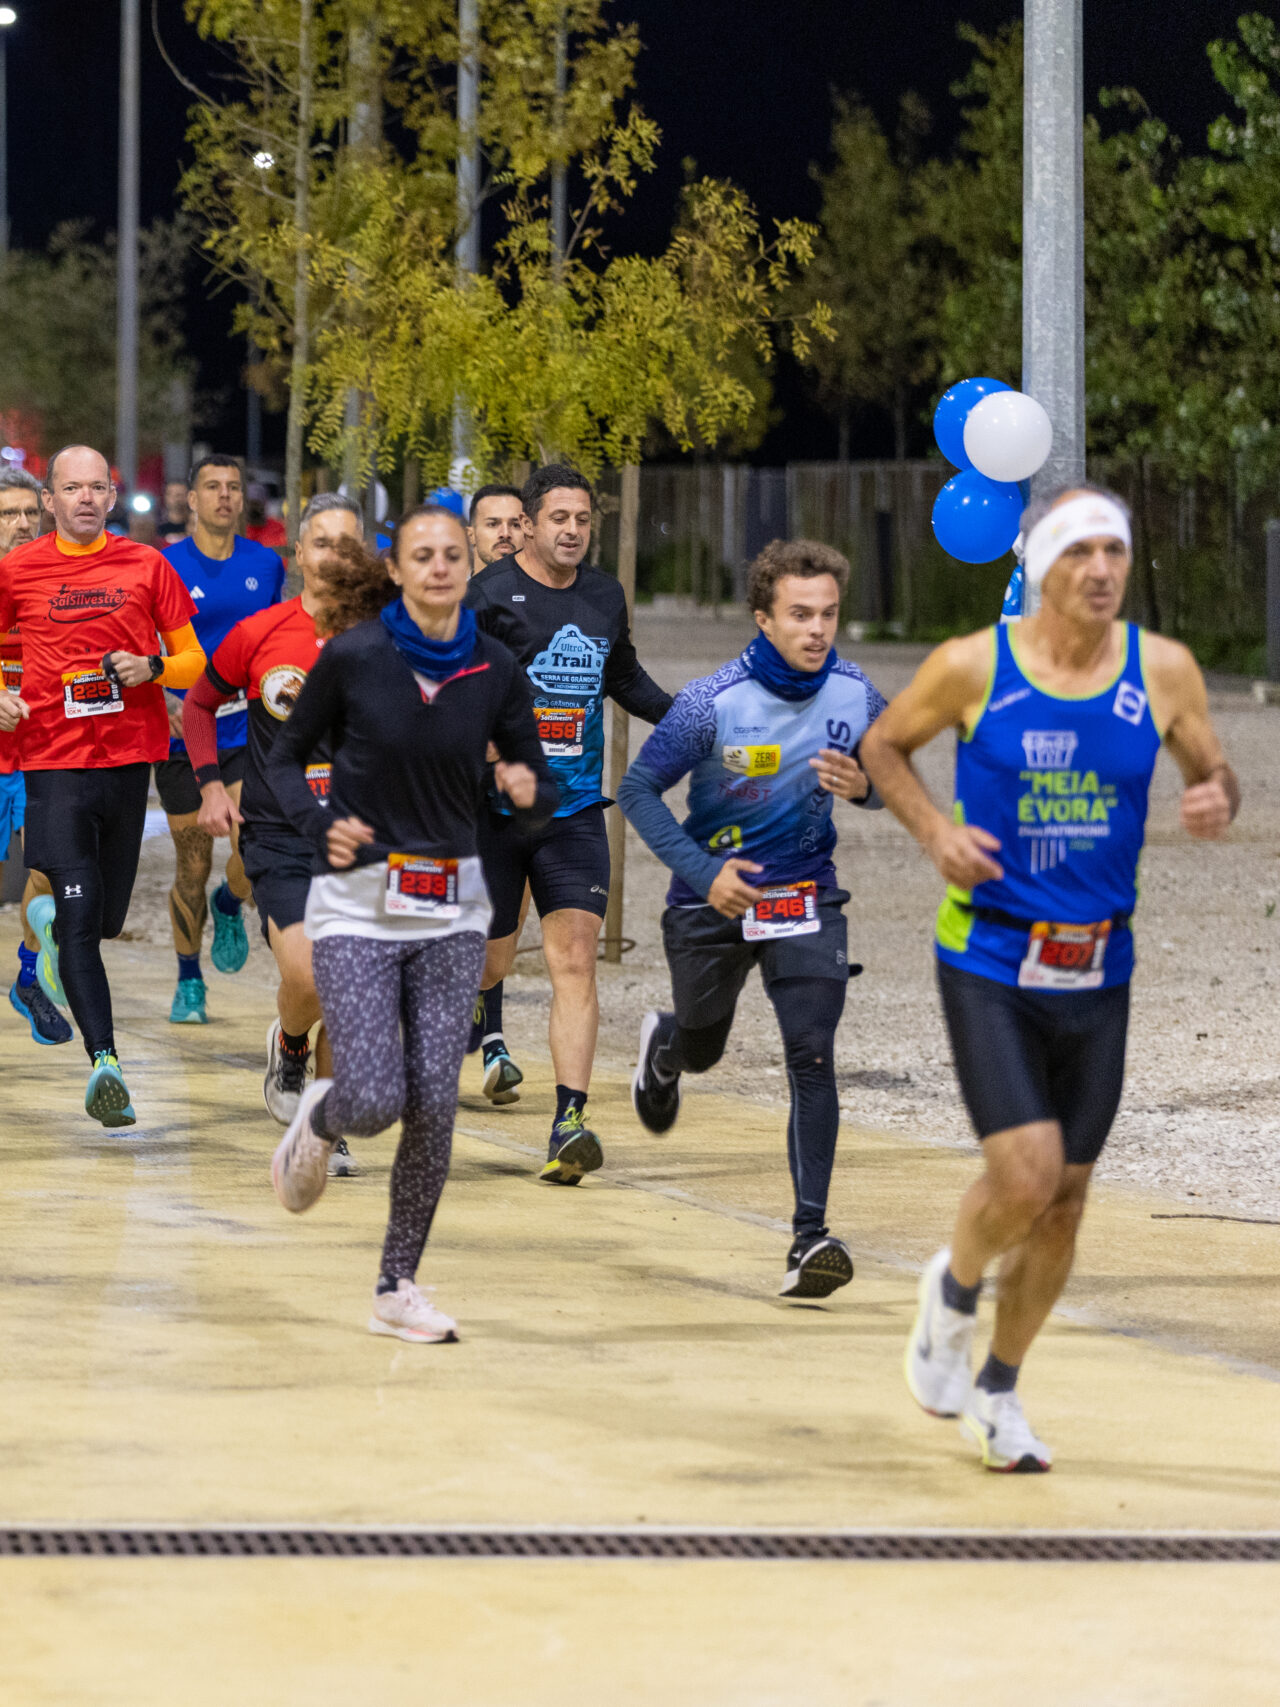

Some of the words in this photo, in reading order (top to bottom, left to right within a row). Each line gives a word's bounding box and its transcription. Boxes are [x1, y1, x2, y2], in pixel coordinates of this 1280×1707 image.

[560, 643, 583, 652] Ultra
[551, 653, 592, 669] Trail
[540, 674, 561, 682] SERRA
[72, 680, 111, 701] 225
[537, 721, 576, 740] 258
[400, 872, 448, 897] 233
[755, 898, 805, 920] 246
